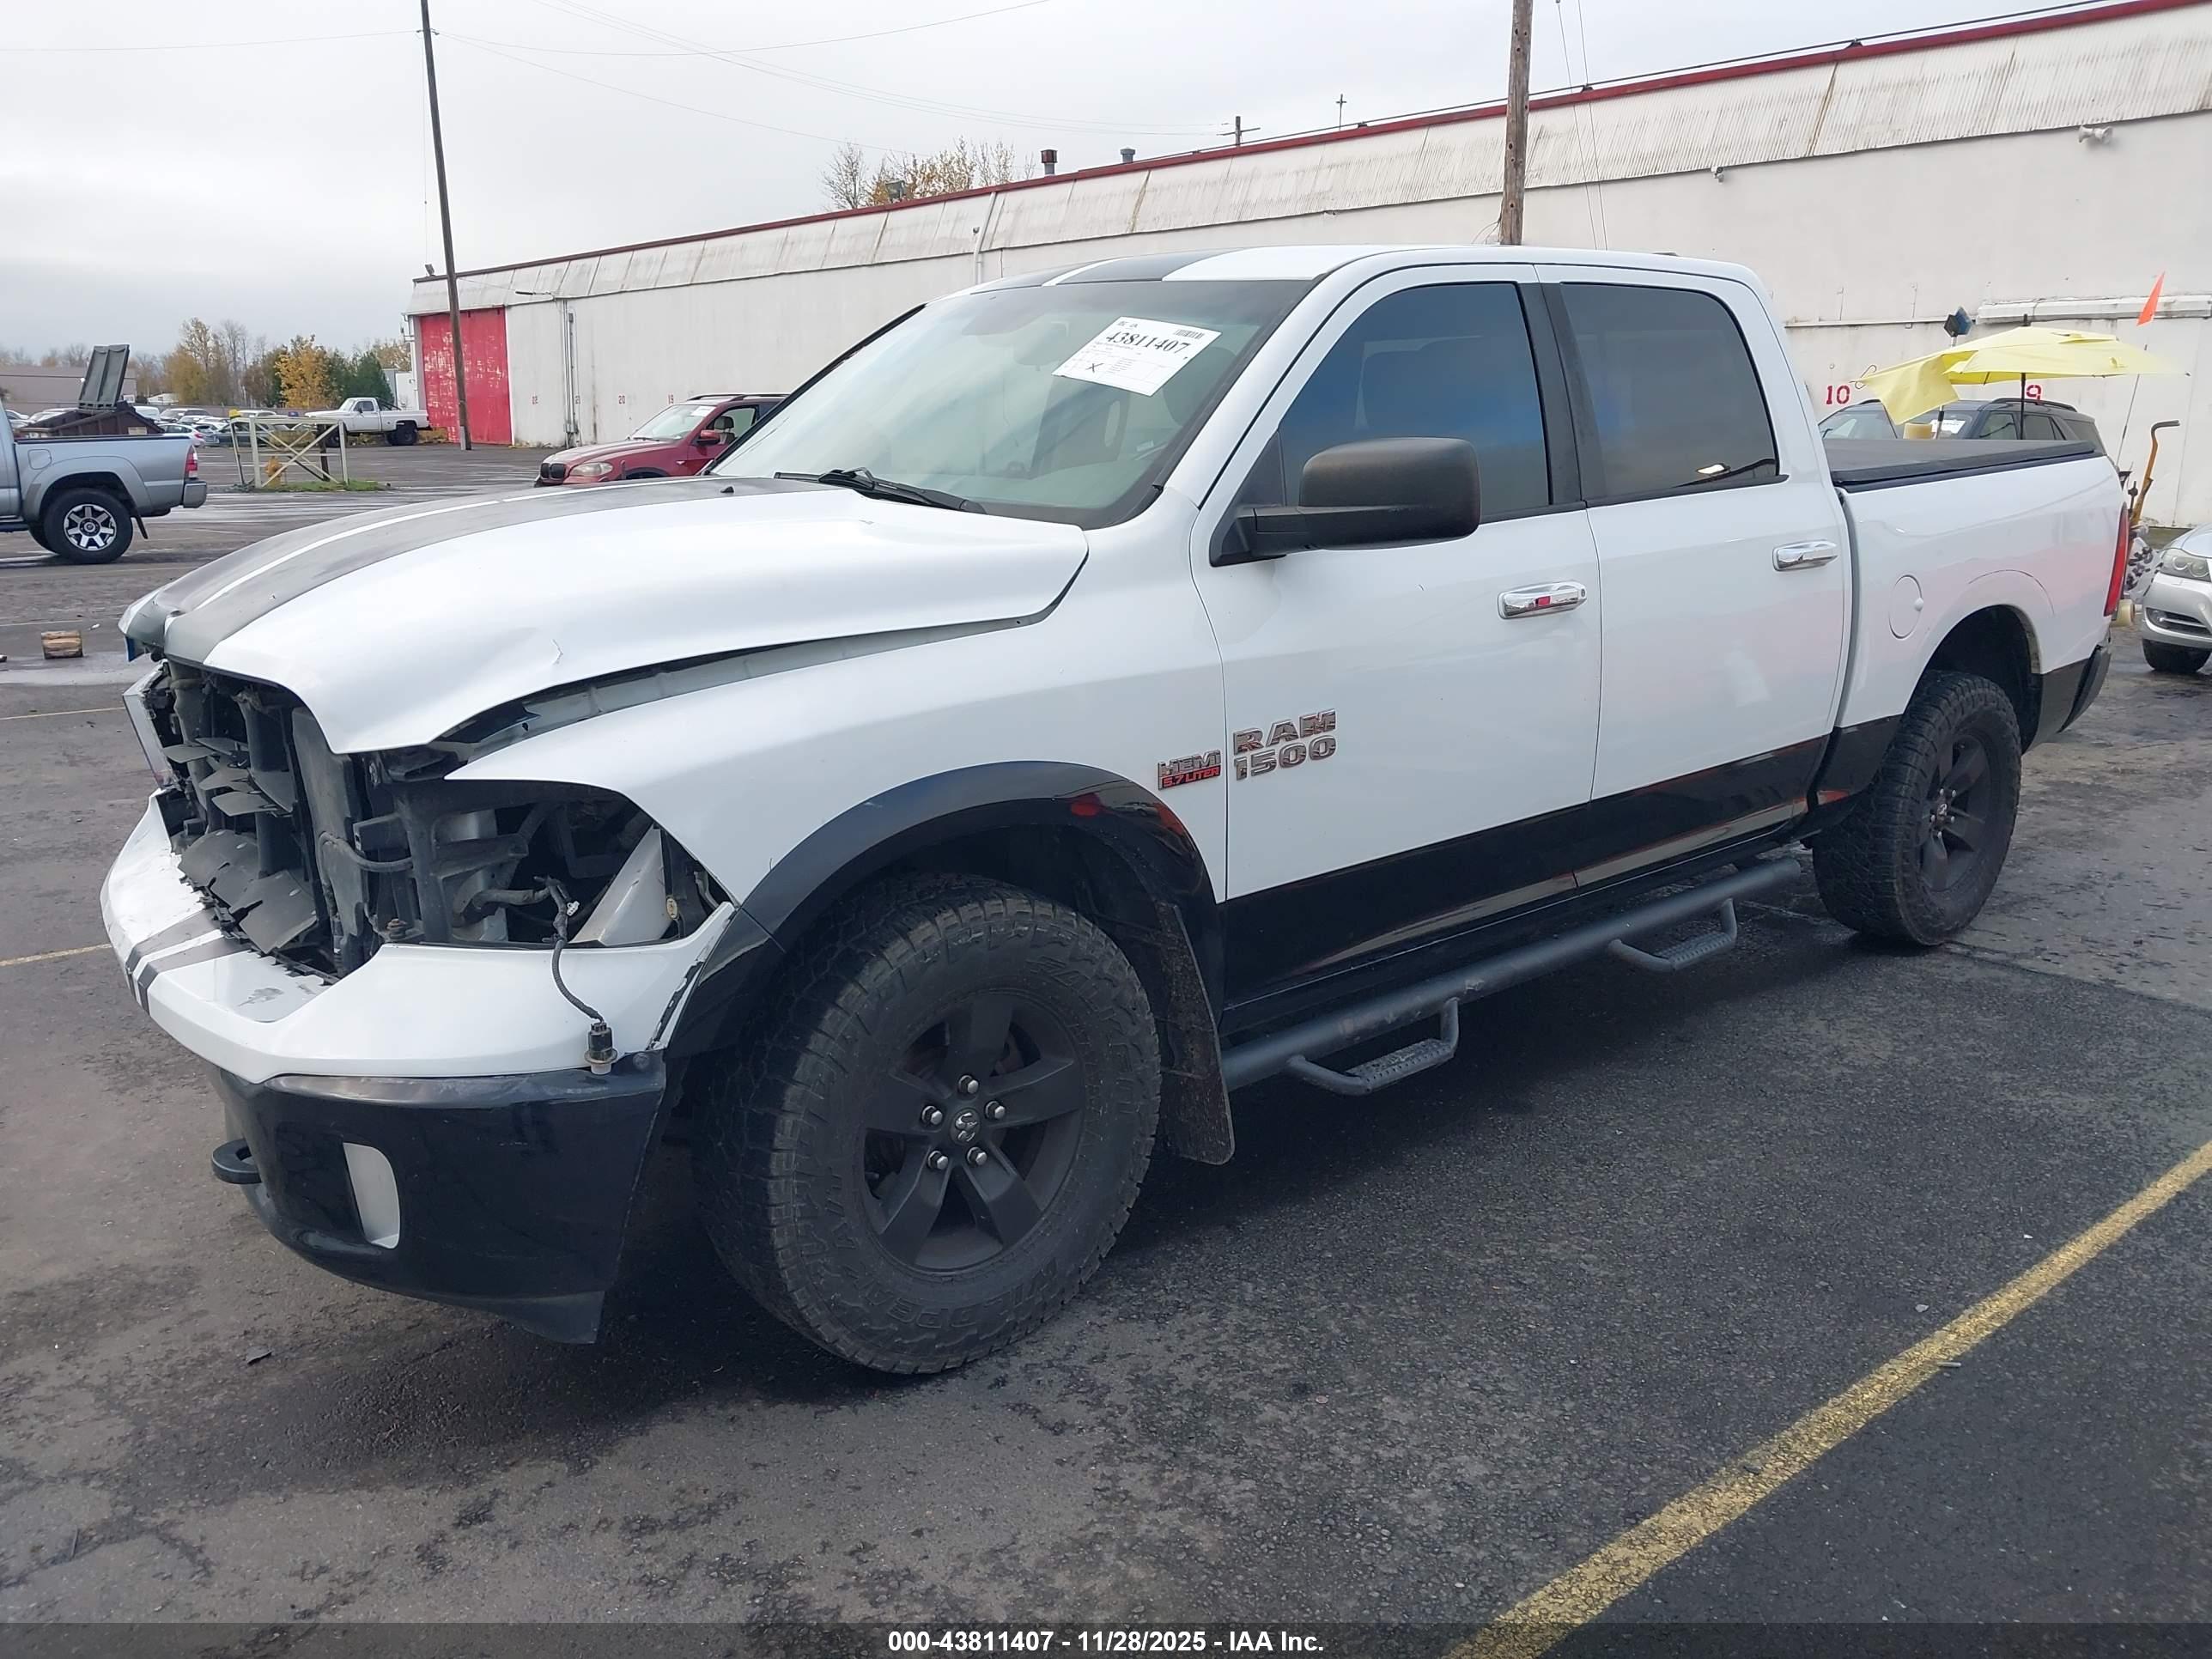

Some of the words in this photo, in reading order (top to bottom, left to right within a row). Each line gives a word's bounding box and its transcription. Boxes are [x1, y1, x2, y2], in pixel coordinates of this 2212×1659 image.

[1106, 331, 1191, 354] 43811407
[1826, 385, 1850, 404] 10
[1233, 708, 1337, 755] RAM
[1158, 750, 1222, 778] HEMI
[1234, 735, 1337, 781] 1500
[1162, 775, 1186, 788] 5.7
[1185, 765, 1221, 784] LITER
